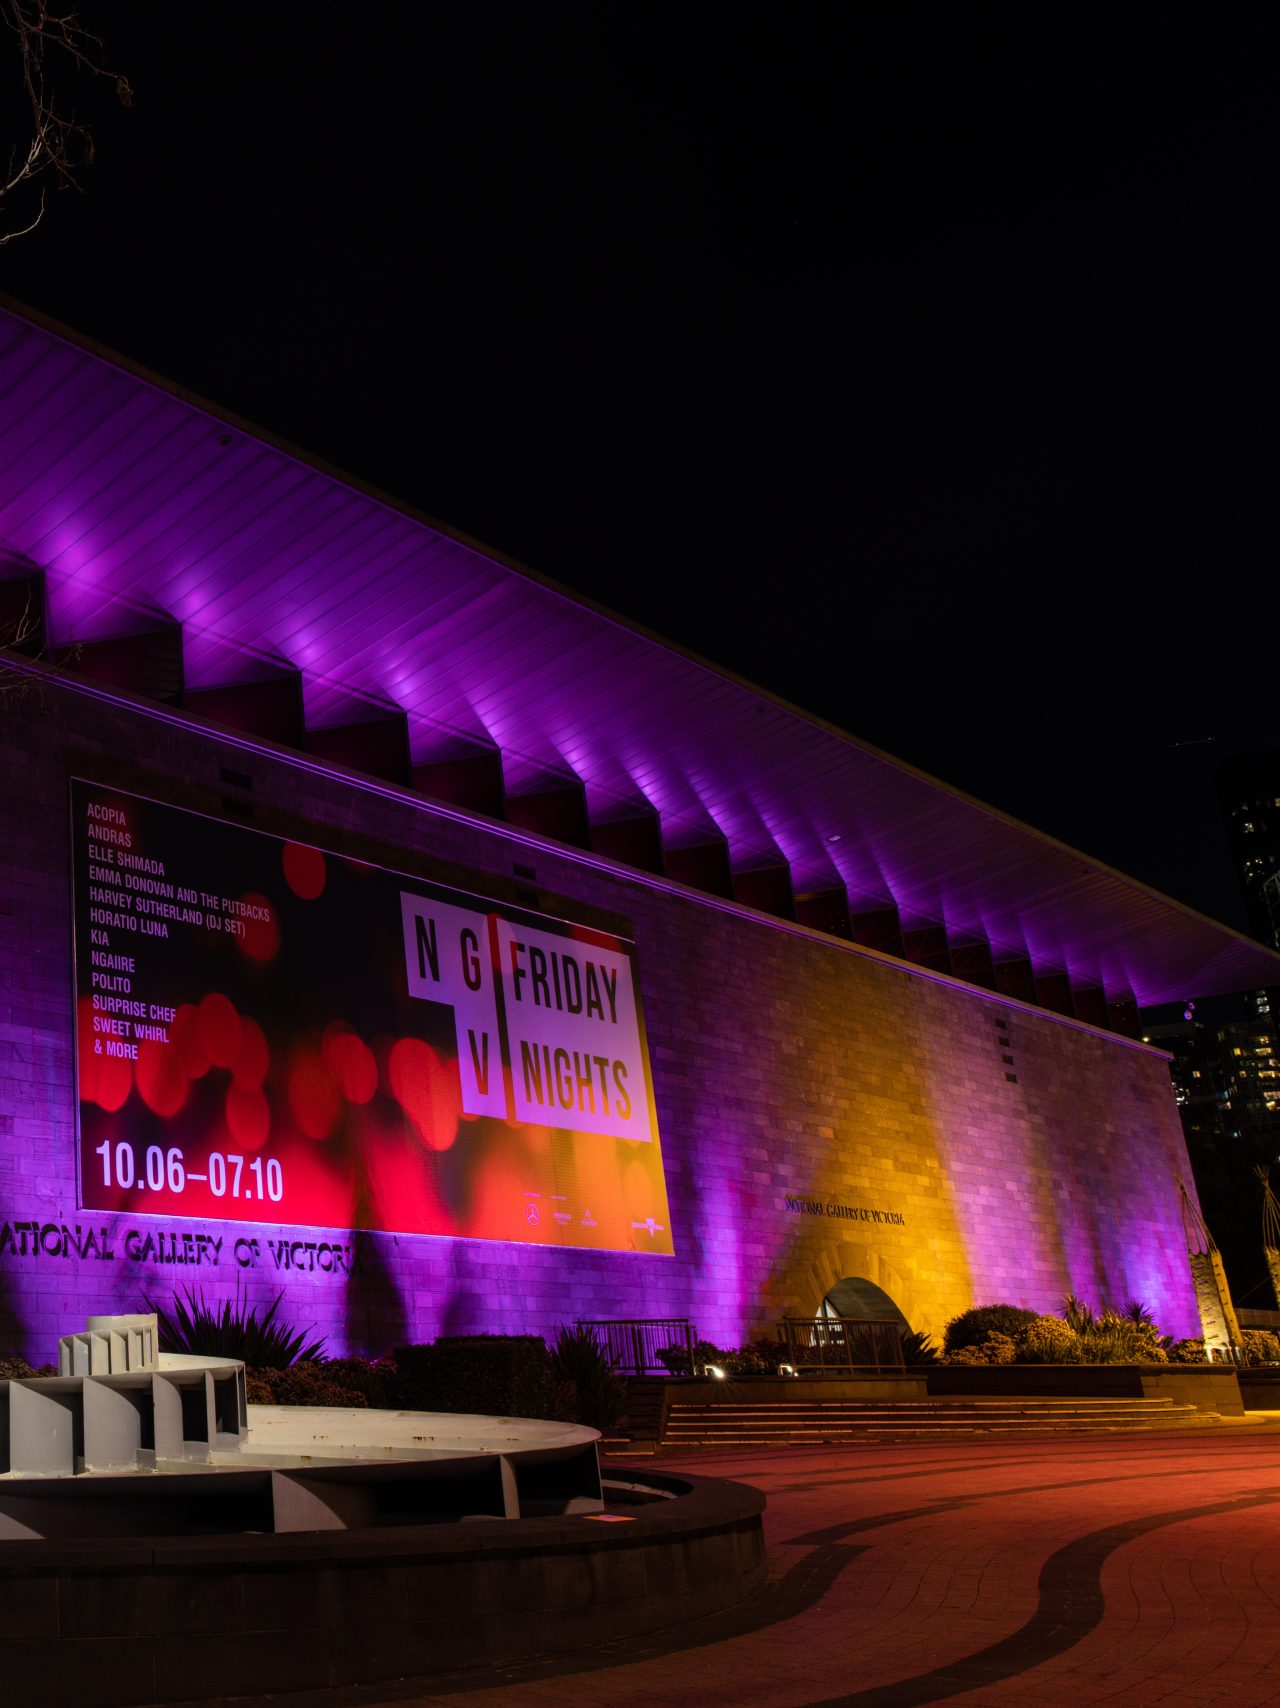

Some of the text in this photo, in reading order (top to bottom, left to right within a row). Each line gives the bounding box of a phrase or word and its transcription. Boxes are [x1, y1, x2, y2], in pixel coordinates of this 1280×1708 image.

[87, 803, 126, 826] ACOPIA
[88, 824, 131, 847] ANDRAS
[88, 845, 165, 876] ELLE SHIMADA
[89, 866, 269, 922] EMMA DONOVAN AND THE PUTBACKS
[90, 886, 246, 937] HARVEY SUTHERLAND (DJ SET)
[90, 908, 168, 938] HORATIO LUNA
[91, 929, 109, 946] KIA
[91, 950, 135, 973] NGAIIRE
[92, 972, 131, 993] POLITO
[510, 940, 617, 1024] FRIDAY
[93, 994, 176, 1022] SURPRISE CHEF
[93, 1016, 169, 1043] SWEET WHIRL
[94, 1039, 138, 1060] & MORE
[520, 1040, 632, 1120] NIGHTS
[826, 1202, 859, 1220] GALLERY
[860, 1207, 870, 1222] OF
[871, 1209, 905, 1226] VICTORIA
[124, 1230, 222, 1265] GALLERY
[234, 1237, 261, 1268] OF
[268, 1240, 366, 1276] VICTORIA
